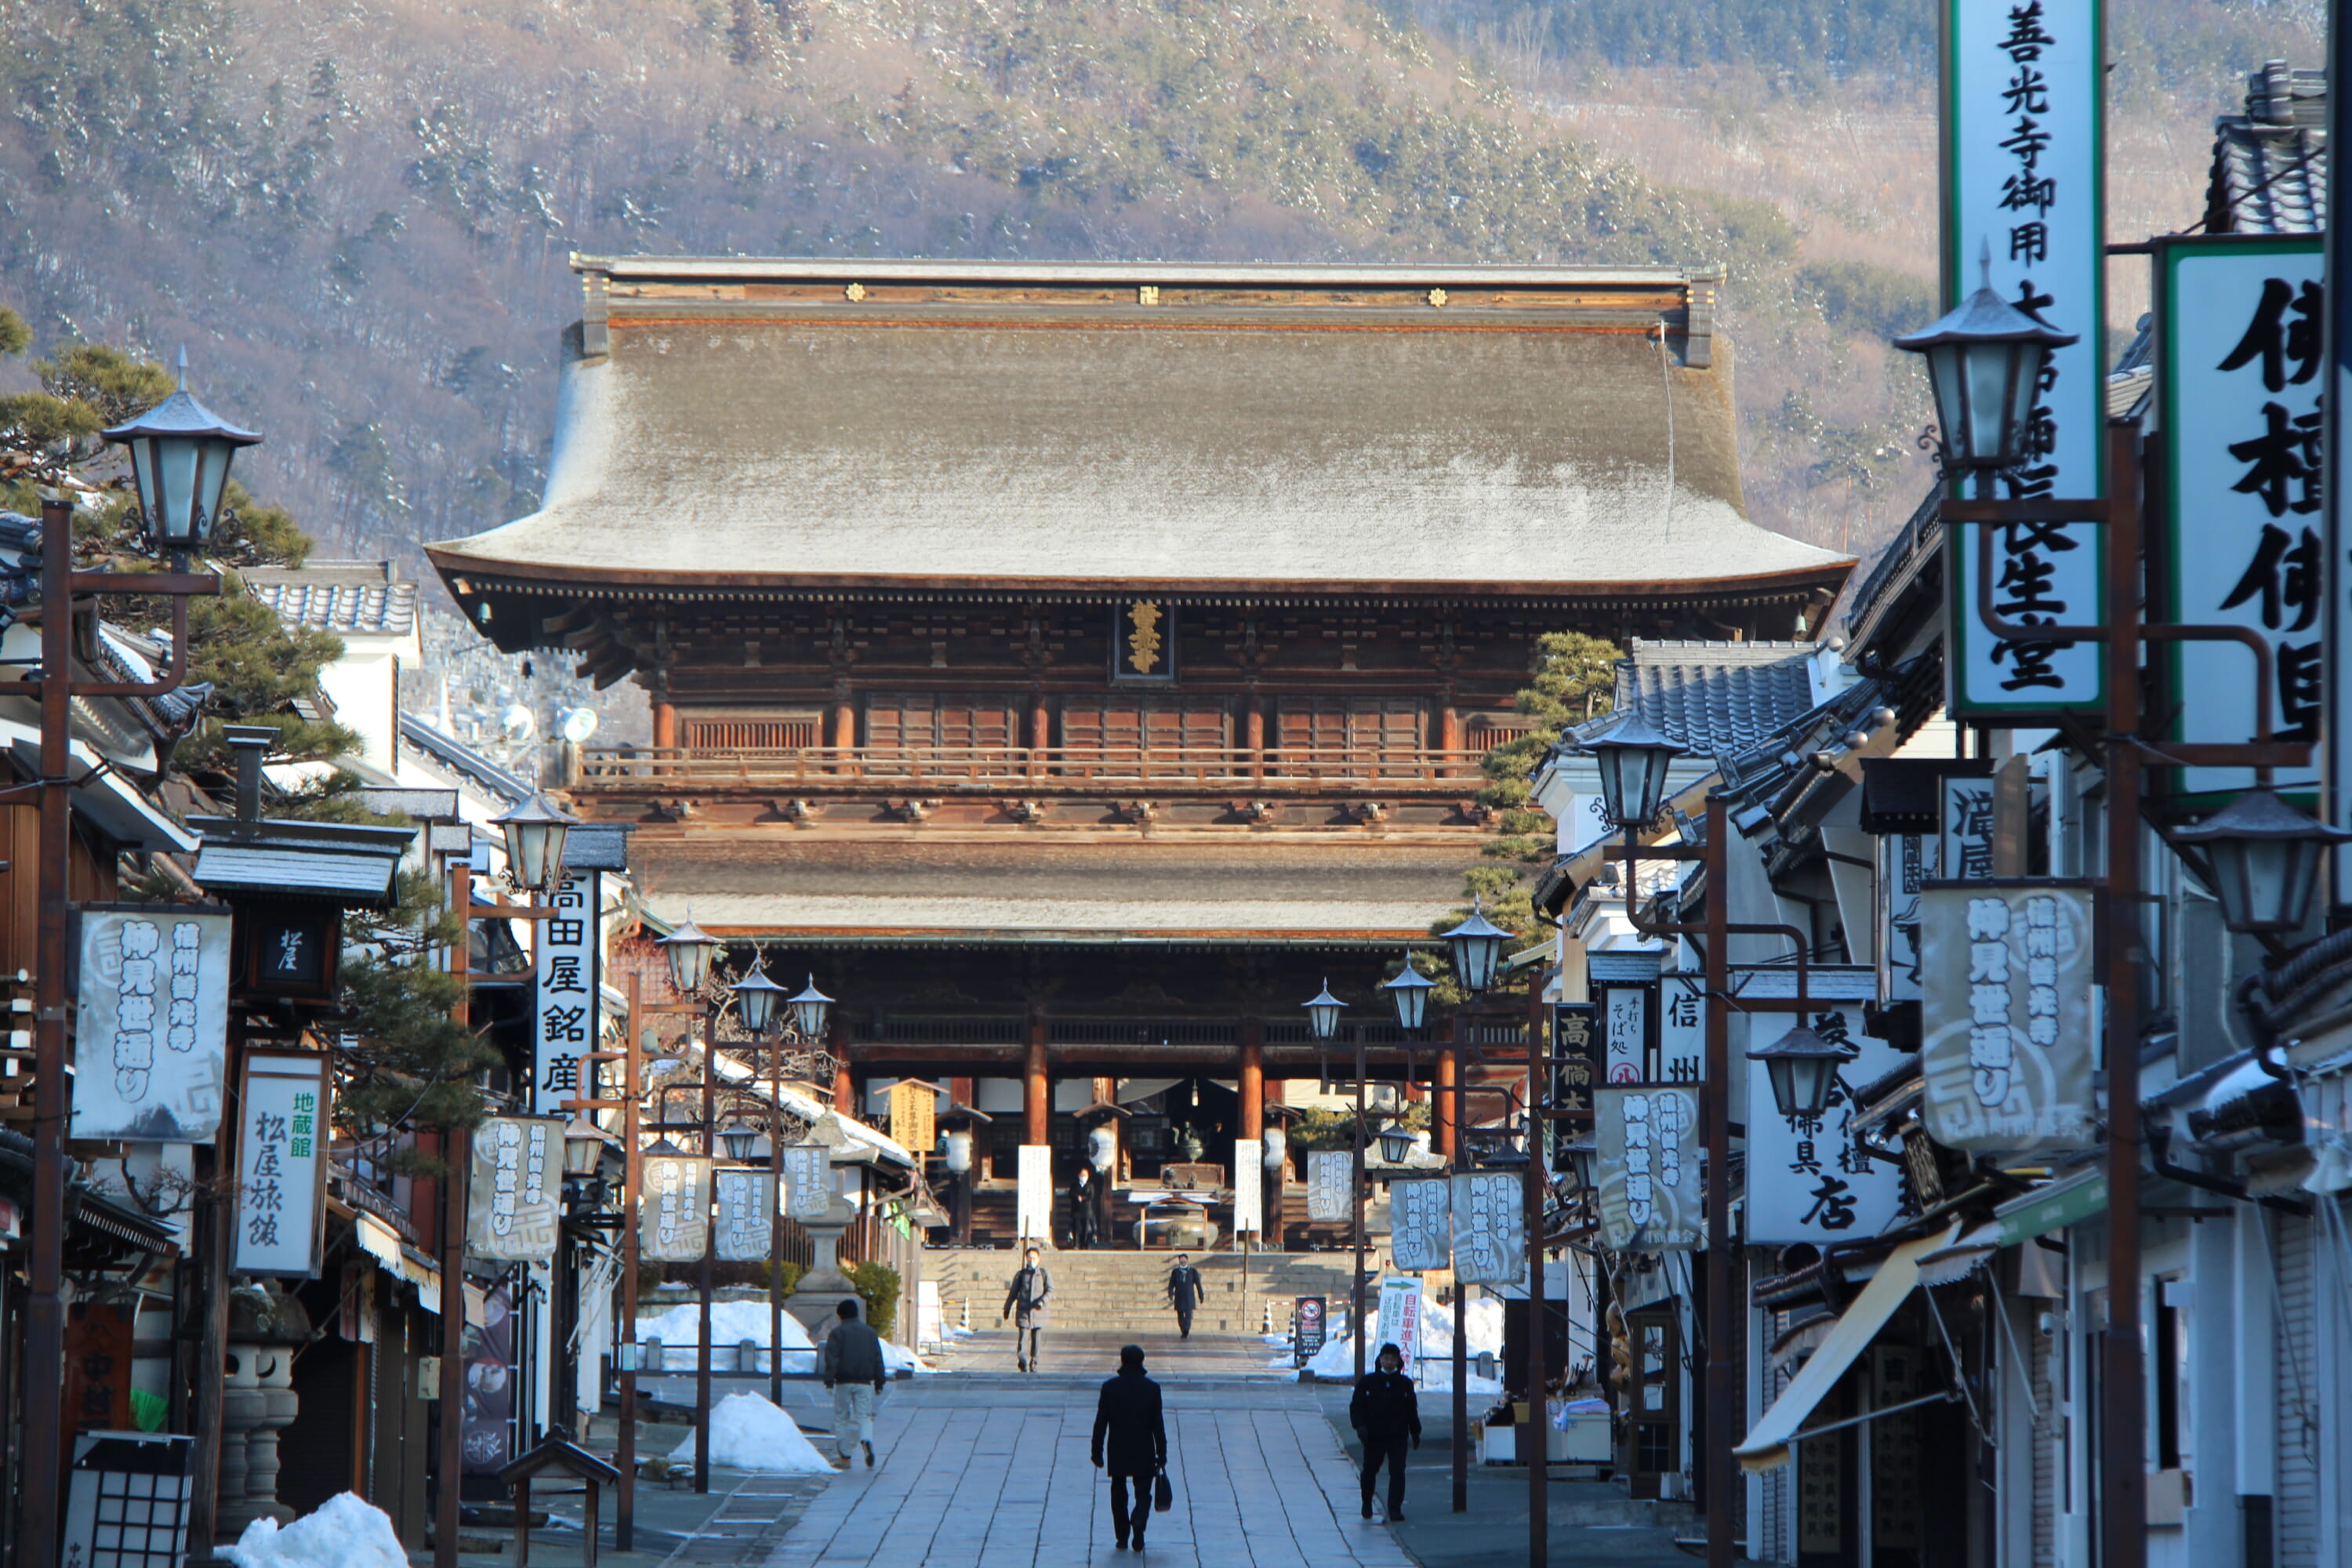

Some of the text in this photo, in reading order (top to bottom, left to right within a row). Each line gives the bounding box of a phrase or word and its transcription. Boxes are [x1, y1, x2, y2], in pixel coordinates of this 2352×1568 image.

[113, 920, 161, 1104] 仲見世通り
[169, 922, 201, 1053] 信州善光寺
[543, 874, 587, 1116] 高田屋銘産
[1966, 896, 2014, 1108] 仲見世通り
[2026, 896, 2060, 1047] 信州善光寺
[1610, 1003, 1629, 1056] そば処
[290, 1092, 314, 1159] 地蔵館
[491, 1123, 522, 1236] 仲見世通り
[524, 1124, 547, 1206] 信州善光寺
[1622, 1094, 1653, 1225] 仲見世通り
[1658, 1093, 1681, 1188] 信州善光寺
[659, 1161, 680, 1245] 仲見世通り
[1468, 1176, 1490, 1268] 仲見世通り
